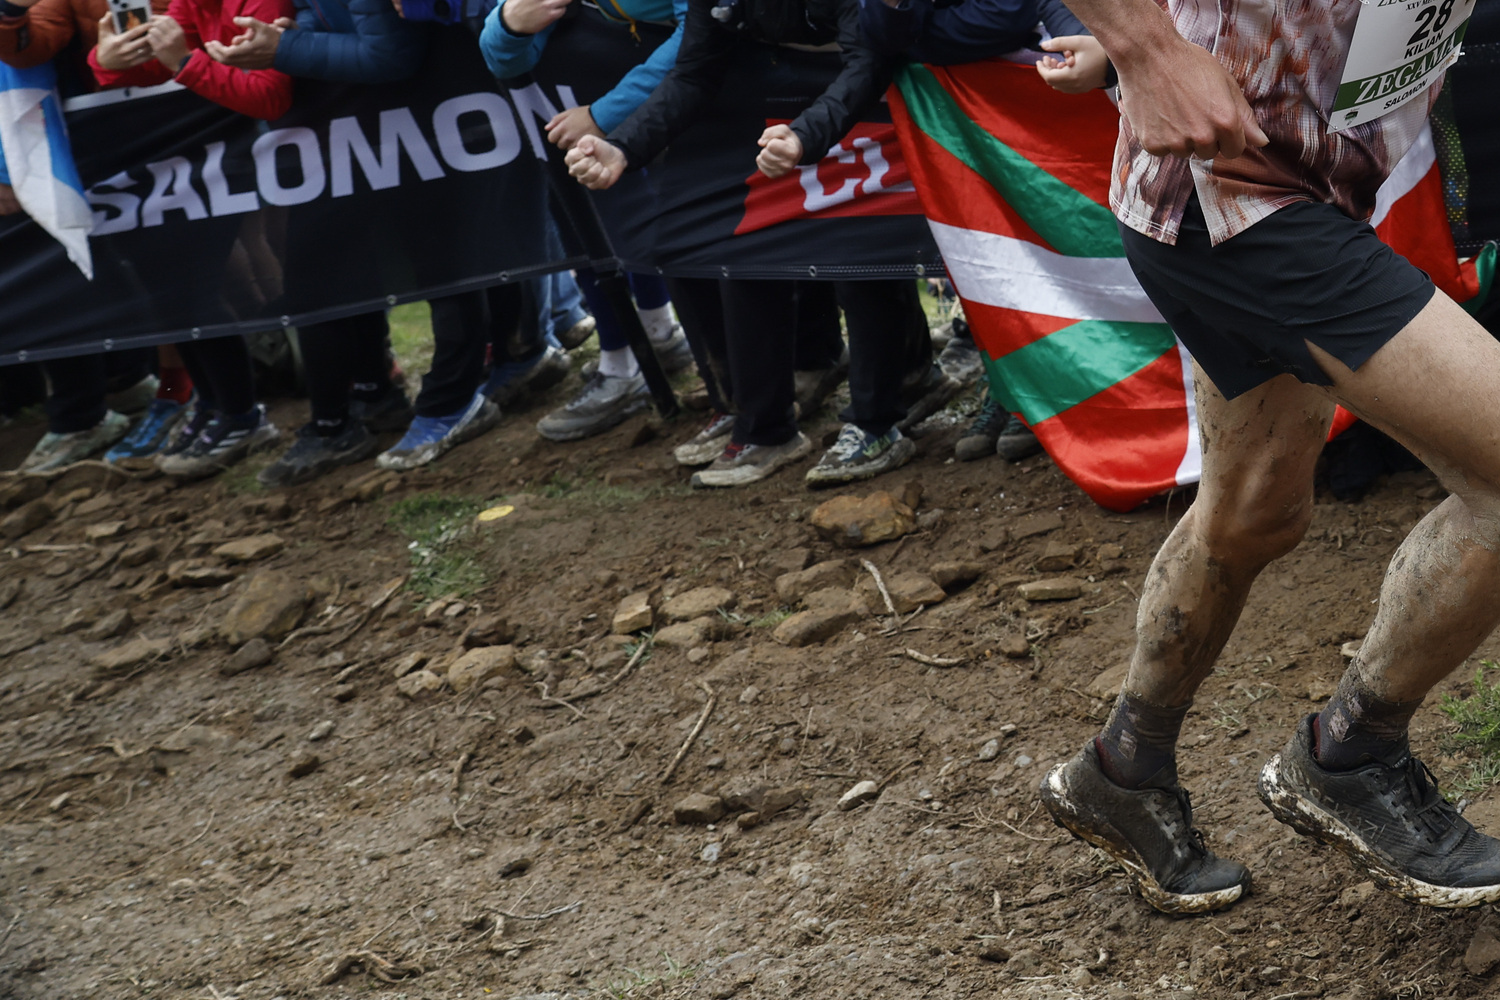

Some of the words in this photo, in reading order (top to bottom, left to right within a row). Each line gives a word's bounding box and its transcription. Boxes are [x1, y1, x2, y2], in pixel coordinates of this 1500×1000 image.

[1354, 31, 1457, 104] ZEGAMA
[1404, 29, 1444, 59] KILIAN
[1383, 78, 1428, 110] SALOMON
[84, 82, 581, 237] SALOMON
